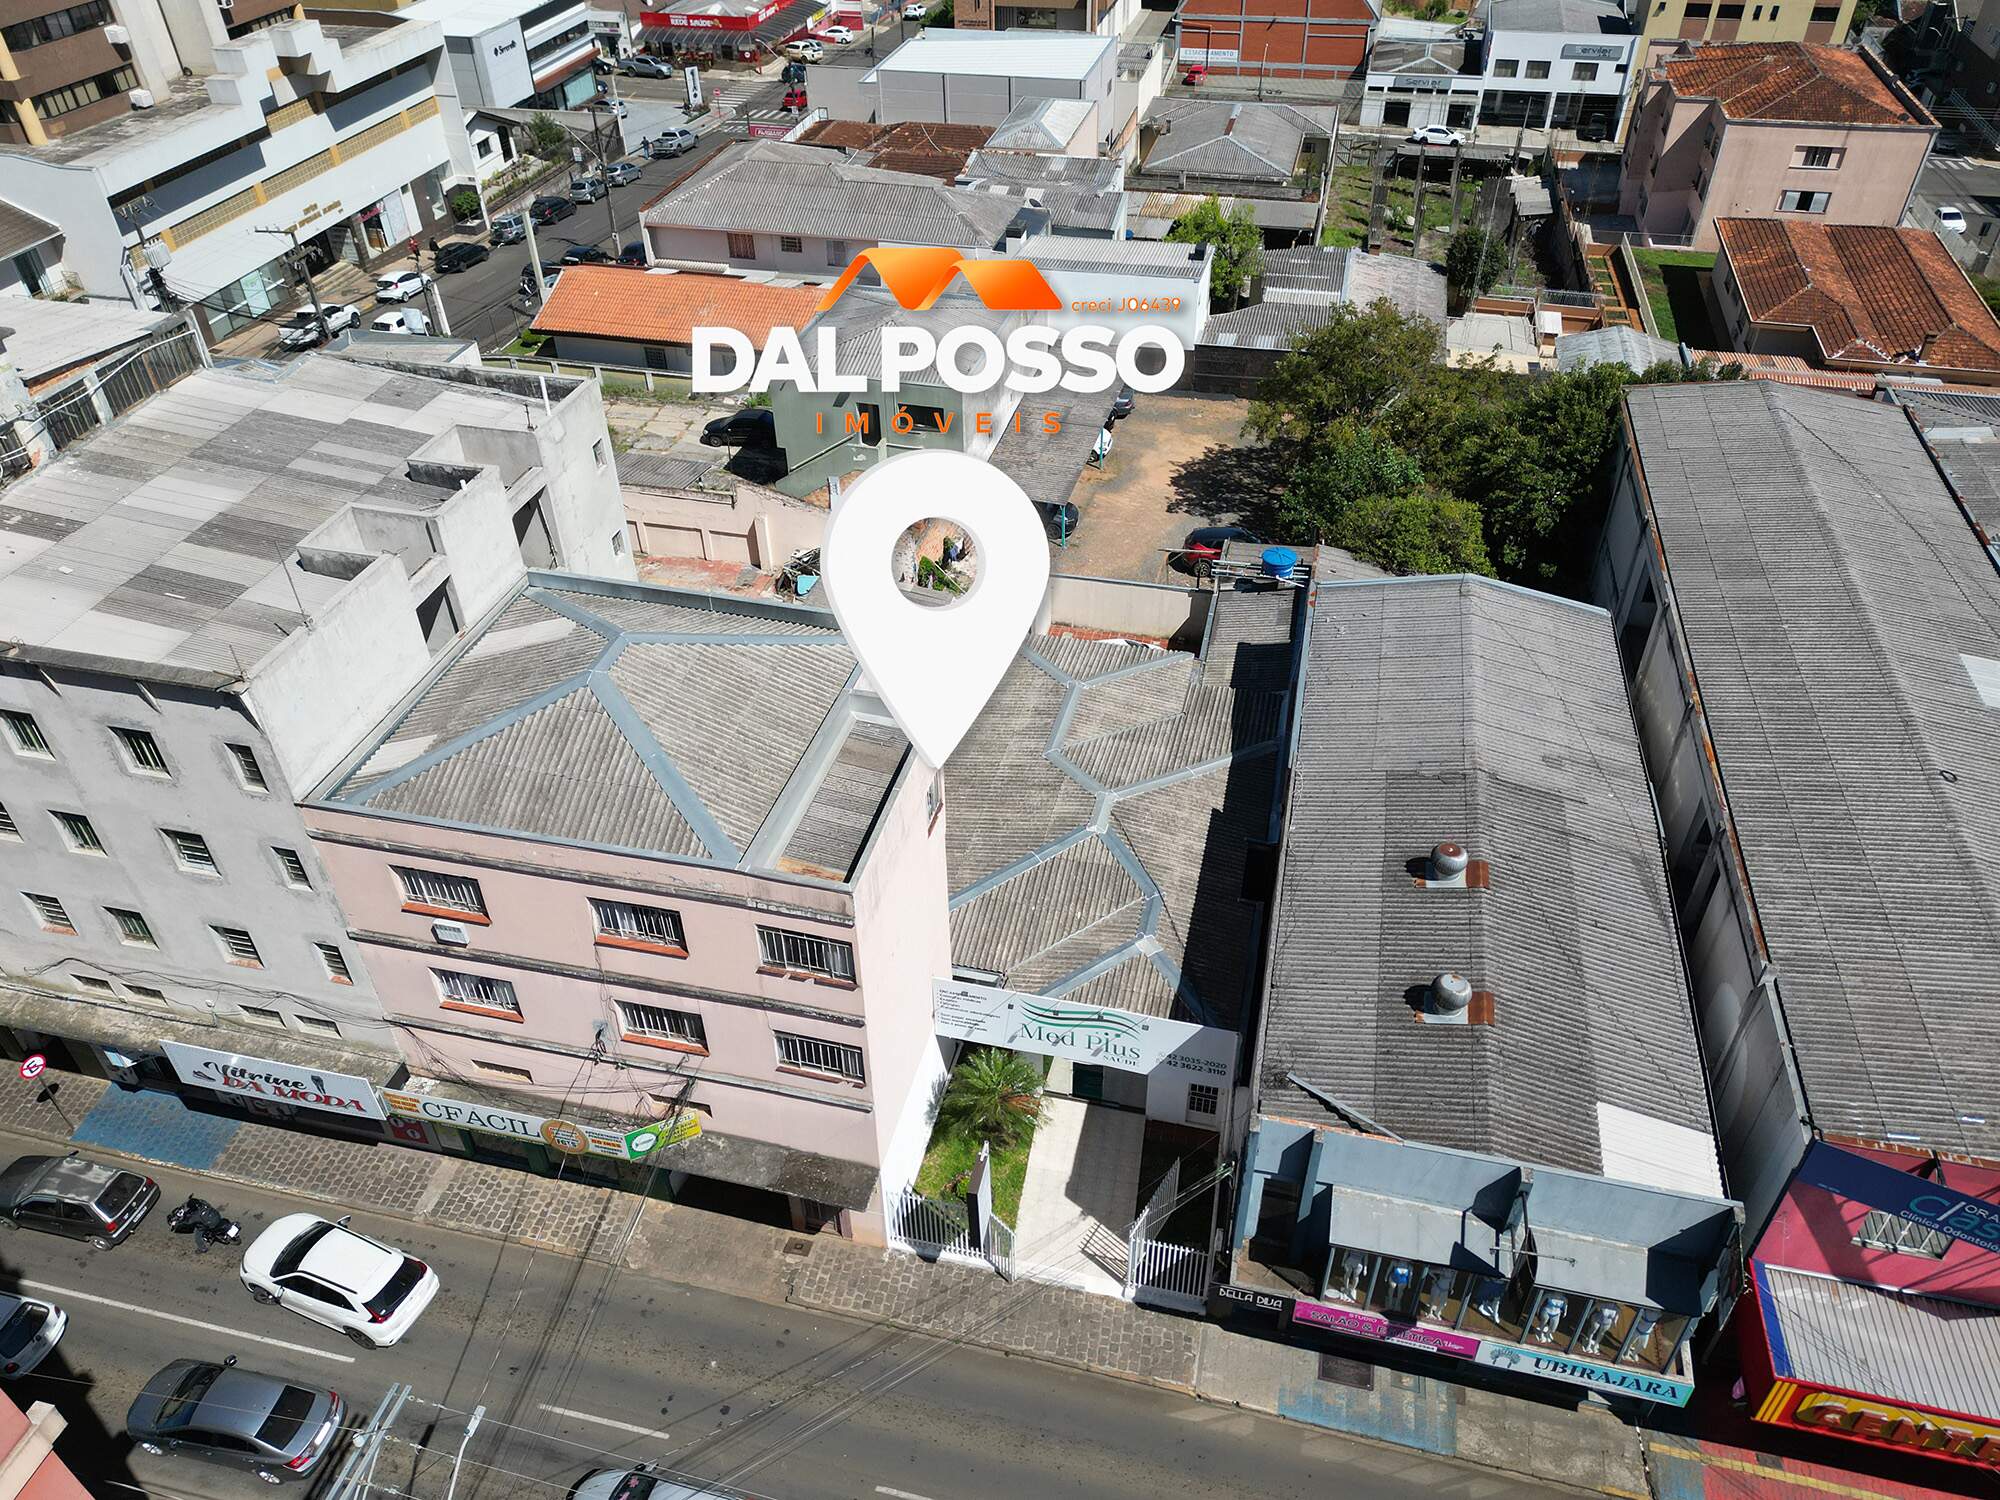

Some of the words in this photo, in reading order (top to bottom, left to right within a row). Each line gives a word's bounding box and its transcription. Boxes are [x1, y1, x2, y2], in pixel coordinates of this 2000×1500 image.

[1020, 1023, 1076, 1047] Med
[222, 1076, 269, 1095] DA
[273, 1085, 367, 1112] MODA
[1900, 1210, 1940, 1231] Clínica
[1256, 1294, 1283, 1312] DIVA
[1534, 1356, 1678, 1400] UBIRAJARA
